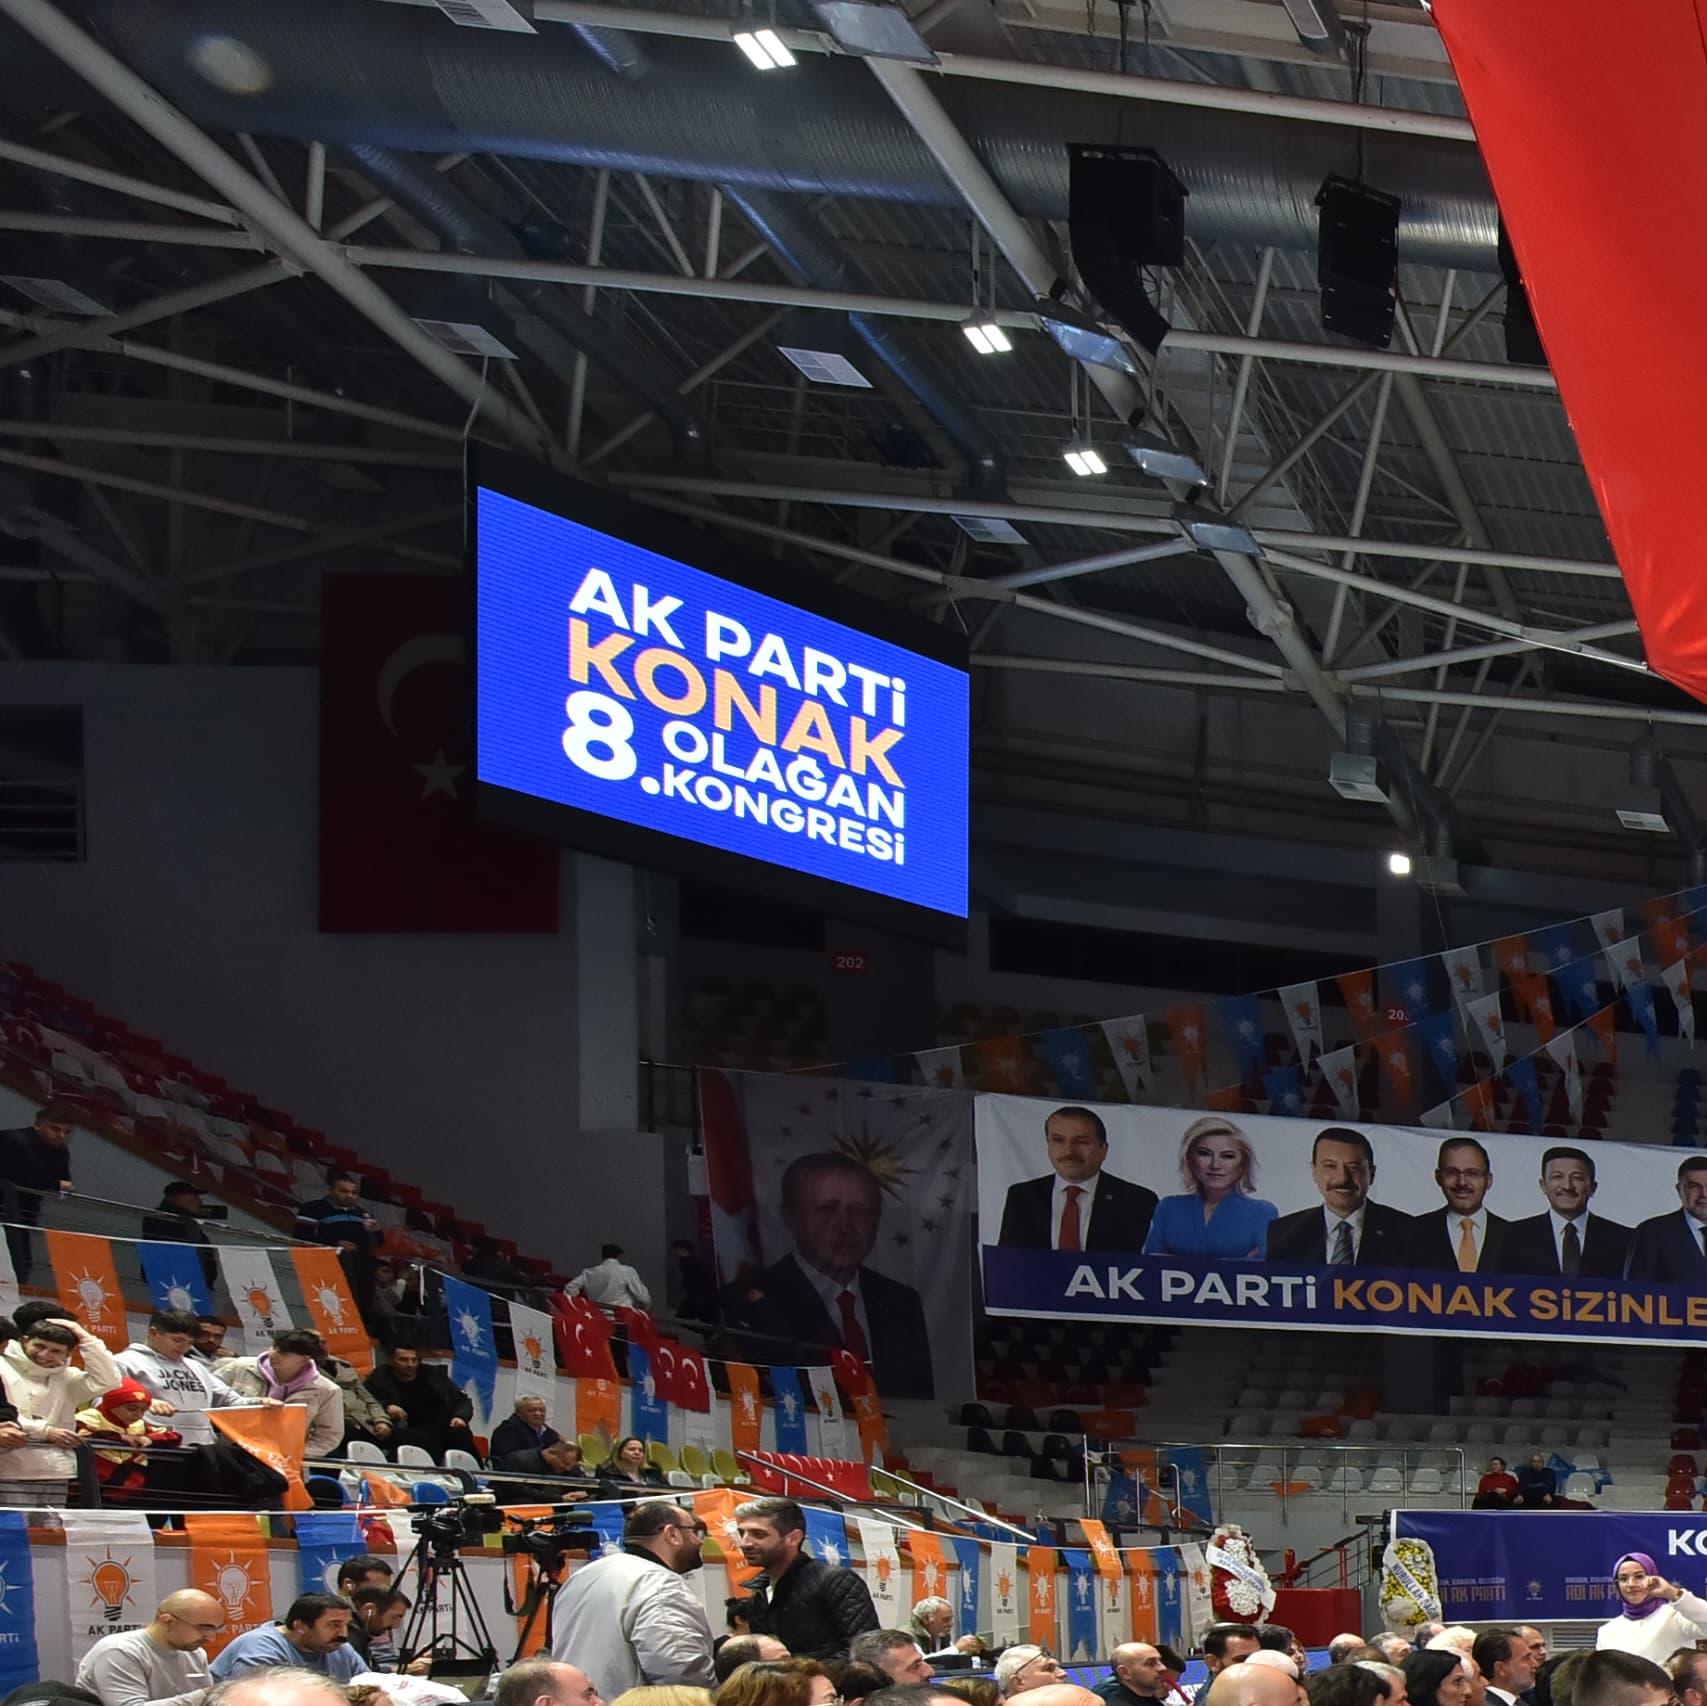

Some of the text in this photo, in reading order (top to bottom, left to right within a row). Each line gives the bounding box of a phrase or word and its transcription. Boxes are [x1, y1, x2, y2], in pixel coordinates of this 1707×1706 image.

[568, 567, 685, 650] AK
[568, 616, 906, 789] KONAK
[662, 720, 905, 829] OLAĞAN
[836, 955, 864, 968] 202
[1388, 1009, 1408, 1020] 20
[1064, 1265, 1144, 1300] AK
[1332, 1278, 1517, 1319] KONAK
[88, 1625, 104, 1635] AK
